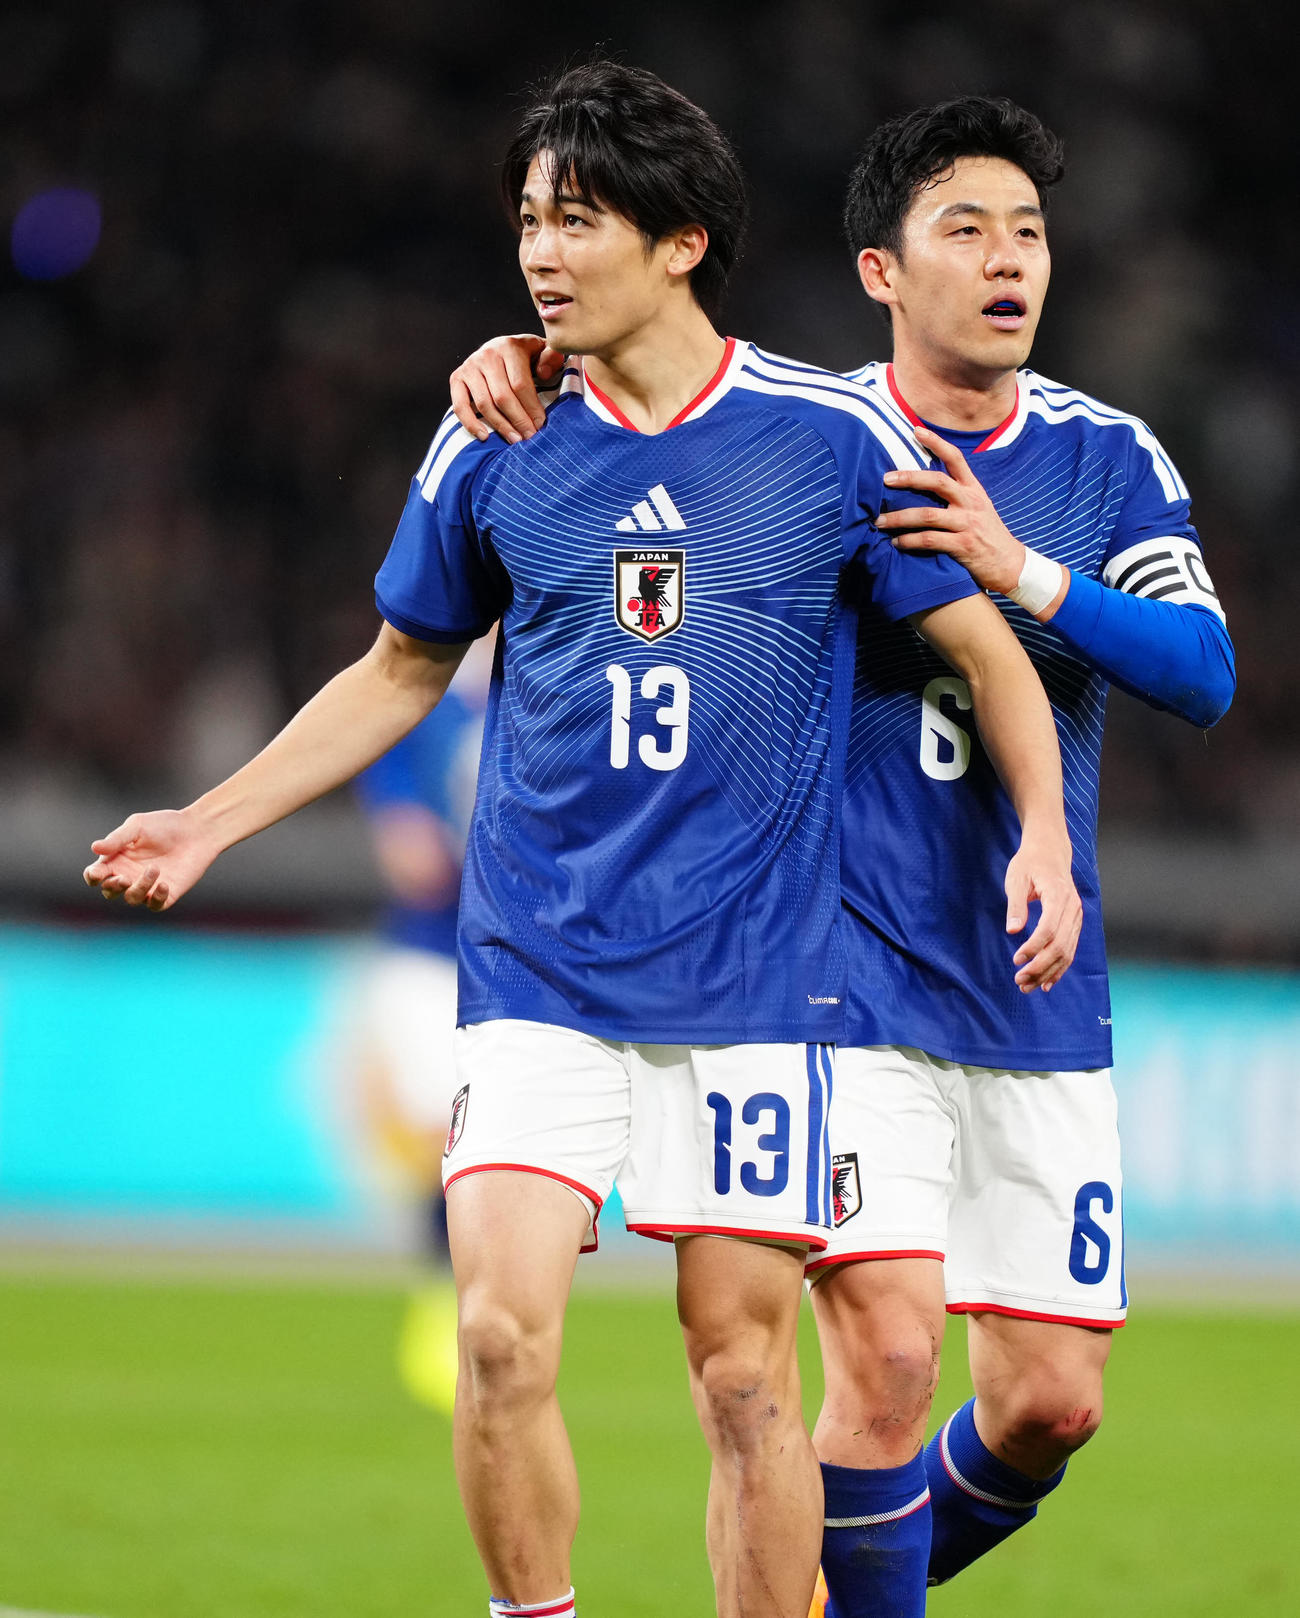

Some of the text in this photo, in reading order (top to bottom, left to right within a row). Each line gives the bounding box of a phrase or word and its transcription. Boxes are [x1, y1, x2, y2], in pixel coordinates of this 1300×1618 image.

[632, 553, 669, 561] JAPAN
[635, 612, 666, 627] JFA
[606, 664, 690, 771] 13
[920, 676, 972, 781] 6
[706, 1091, 790, 1197] 13
[834, 1203, 848, 1216] FA
[1068, 1181, 1113, 1285] 6
